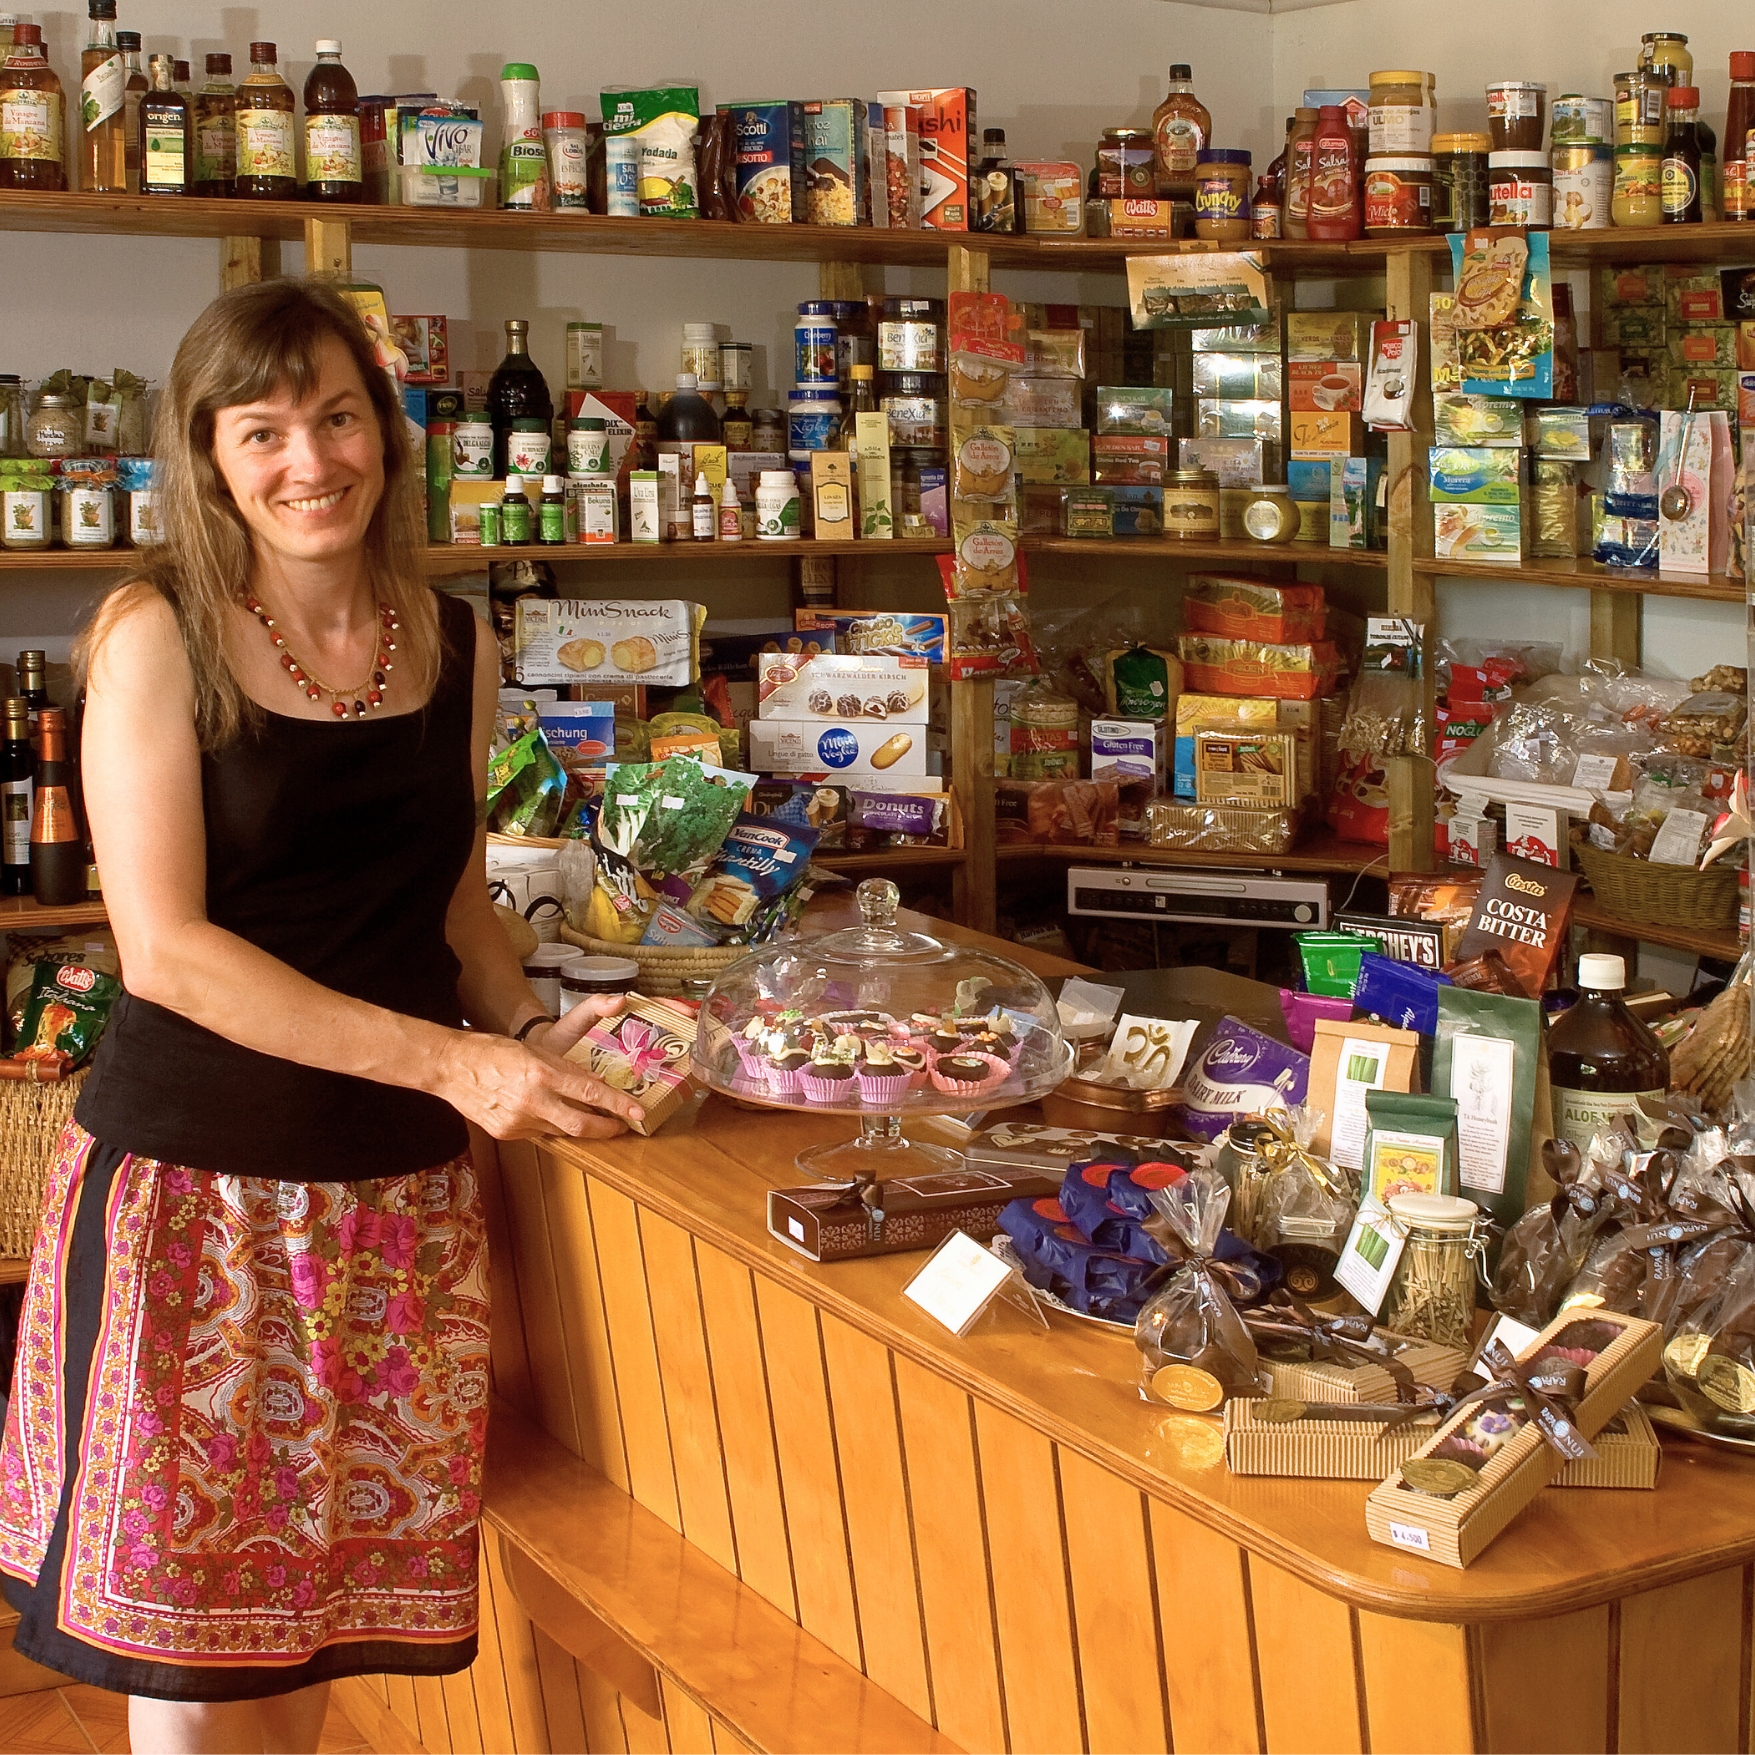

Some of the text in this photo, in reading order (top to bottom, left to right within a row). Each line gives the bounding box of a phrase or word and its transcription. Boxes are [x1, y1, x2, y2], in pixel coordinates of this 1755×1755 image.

[147, 112, 182, 124] origen
[735, 122, 768, 137] Scotti
[1318, 153, 1347, 170] Salsa
[1490, 182, 1532, 200] utella
[1434, 297, 1452, 310] 10
[607, 428, 632, 436] ELIXIR
[1103, 739, 1145, 750] Gluten Free
[768, 750, 789, 759] Lingue
[798, 751, 814, 759] gatto
[863, 798, 926, 815] Donuts
[733, 827, 784, 846] VanCook
[1504, 872, 1546, 898] Costa
[1486, 898, 1548, 931] COSTA
[1476, 913, 1548, 950] BITTER
[1206, 1038, 1254, 1067] Cadbury
[1208, 1089, 1247, 1105] MILK
[873, 1222, 881, 1242] NUI
[1563, 1434, 1586, 1458] NUI
